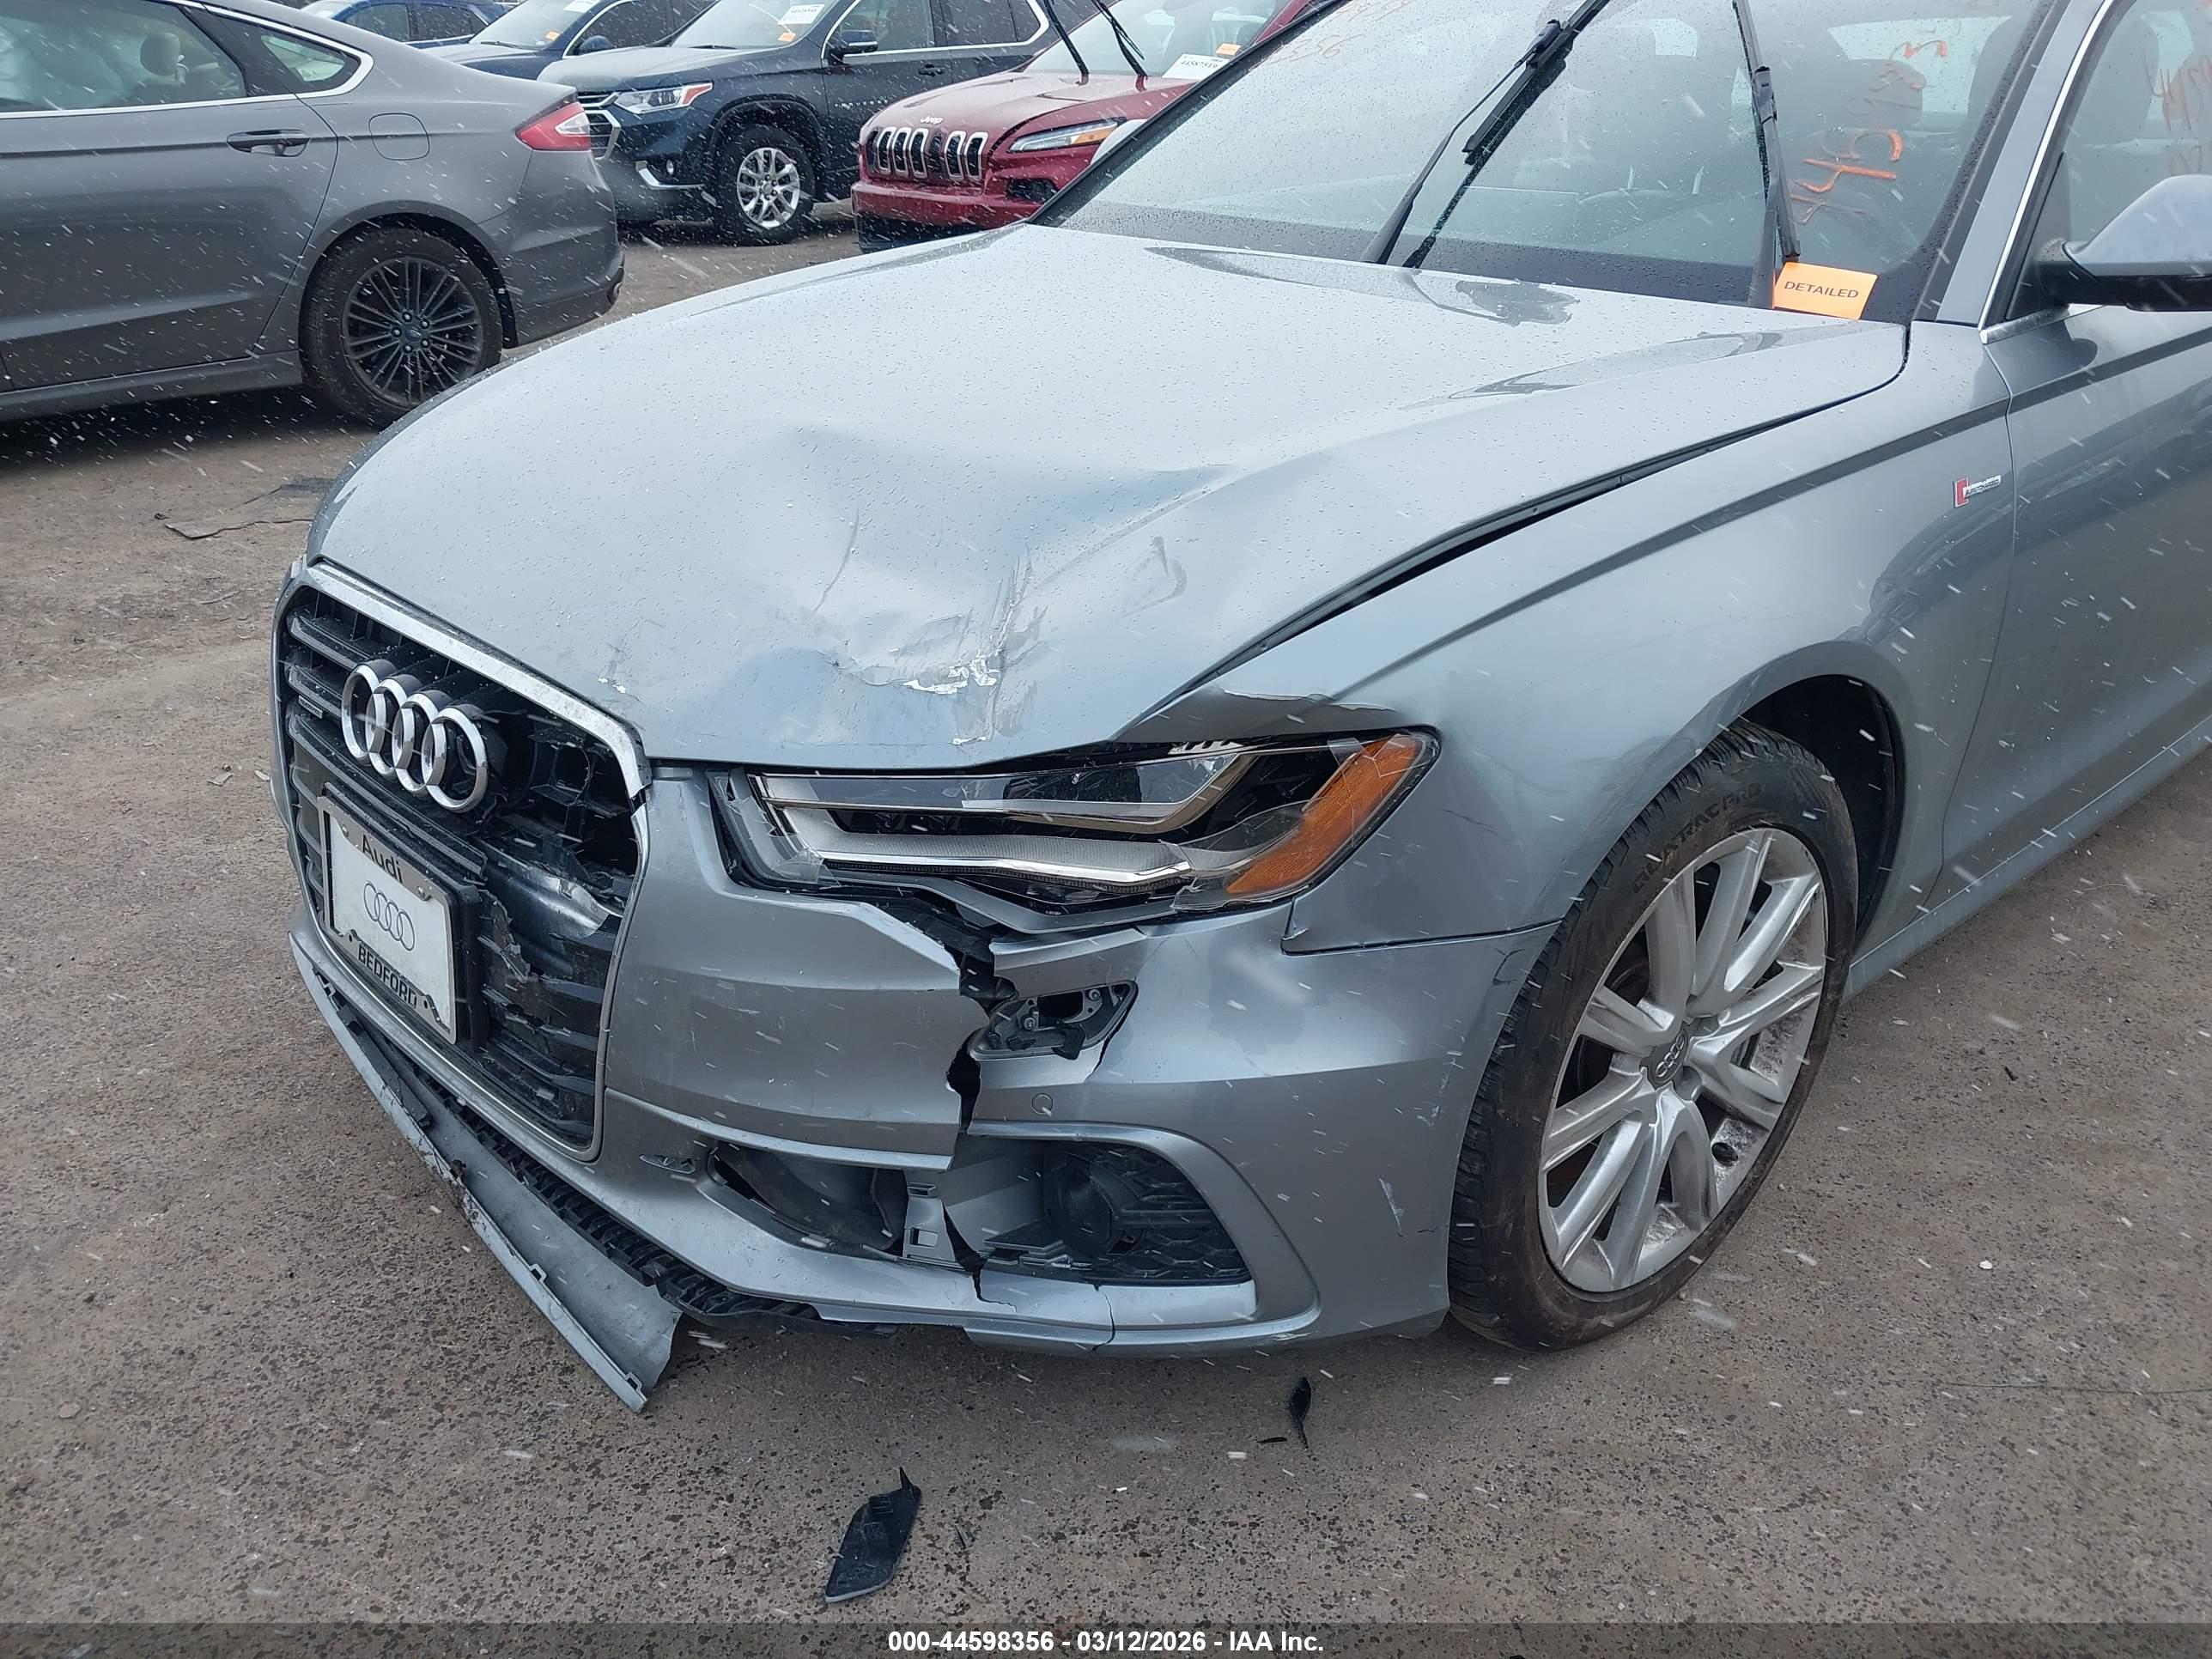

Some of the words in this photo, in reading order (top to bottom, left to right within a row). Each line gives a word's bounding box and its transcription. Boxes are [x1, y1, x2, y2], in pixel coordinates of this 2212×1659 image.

[1784, 280, 1859, 299] DETAILED
[362, 834, 404, 884] Audi
[357, 944, 418, 1010] BEDFORD
